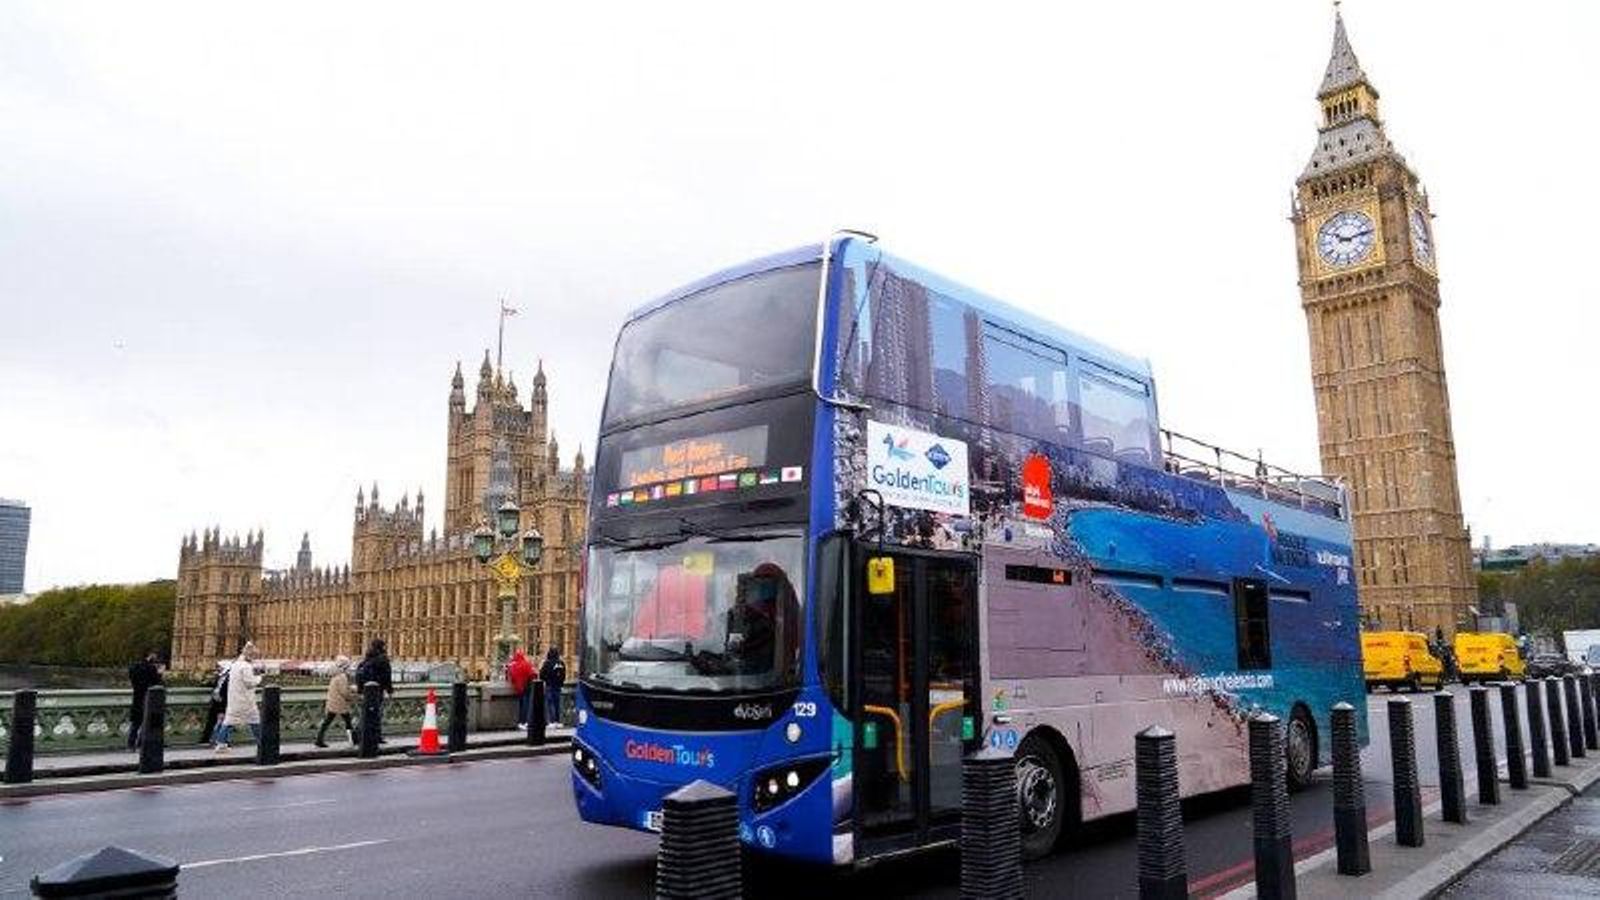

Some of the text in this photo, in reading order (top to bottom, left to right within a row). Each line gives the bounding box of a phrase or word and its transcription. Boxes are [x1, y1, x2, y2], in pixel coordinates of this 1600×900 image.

[873, 465, 964, 498] GoldenTours
[793, 702, 817, 717] 129
[625, 739, 715, 769] GoldenTours
